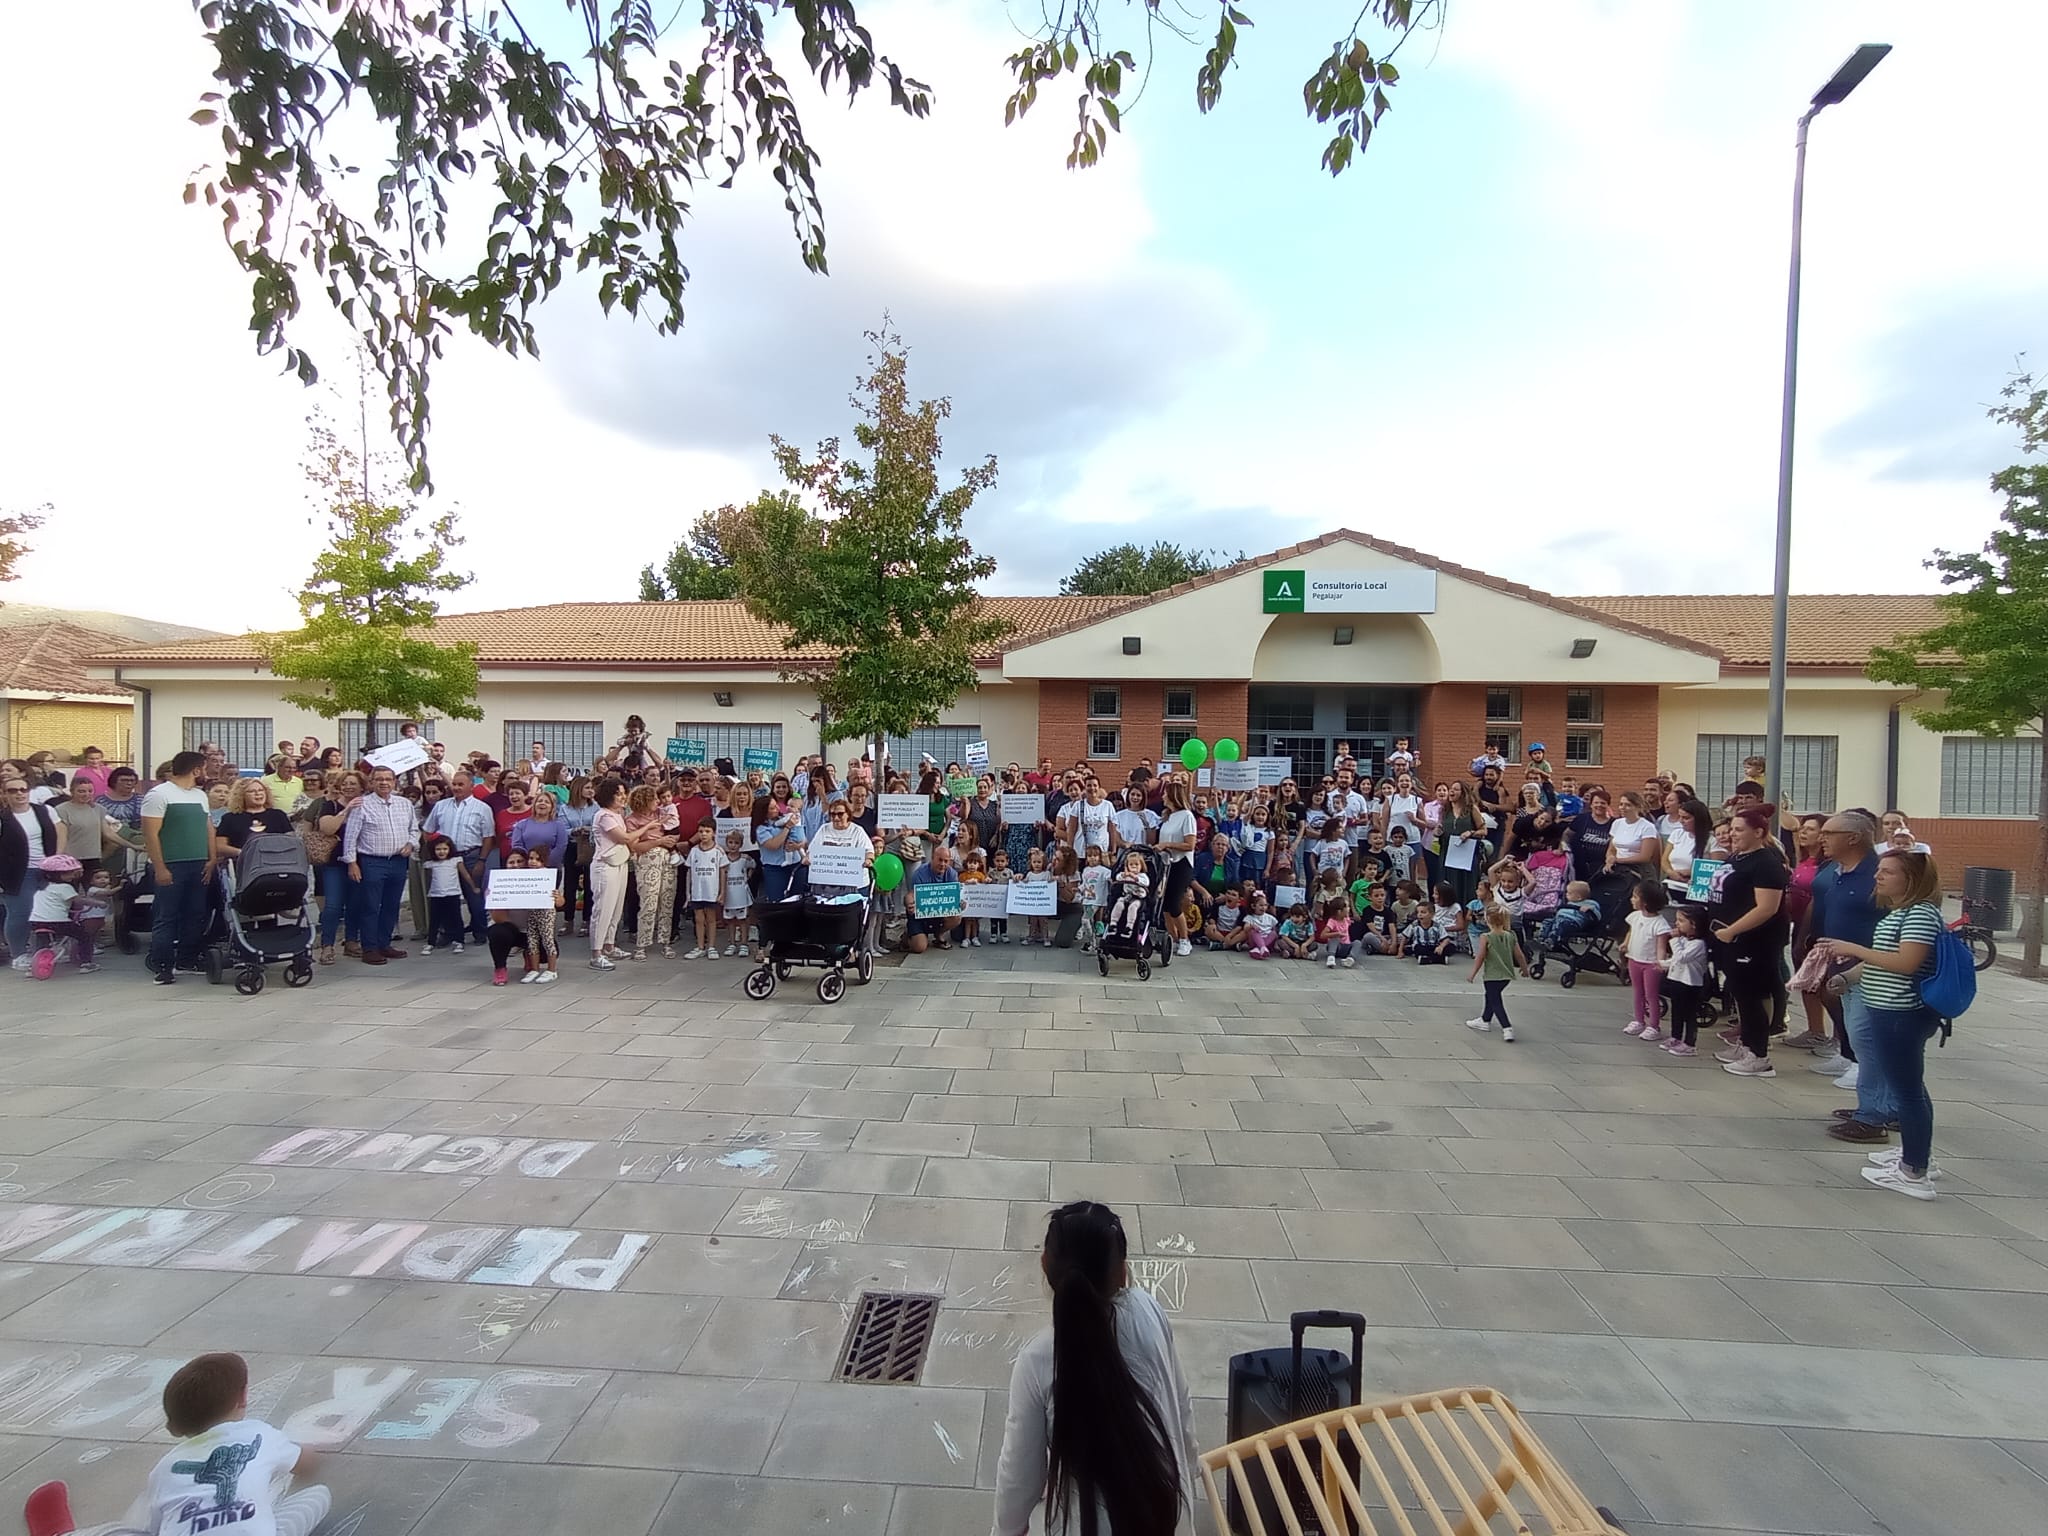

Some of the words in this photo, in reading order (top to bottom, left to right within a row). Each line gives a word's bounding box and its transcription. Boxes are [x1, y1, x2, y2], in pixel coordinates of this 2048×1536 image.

[1312, 582, 1363, 590] Consultorio
[1364, 582, 1387, 590] Local
[1312, 593, 1343, 601] Pegalajar
